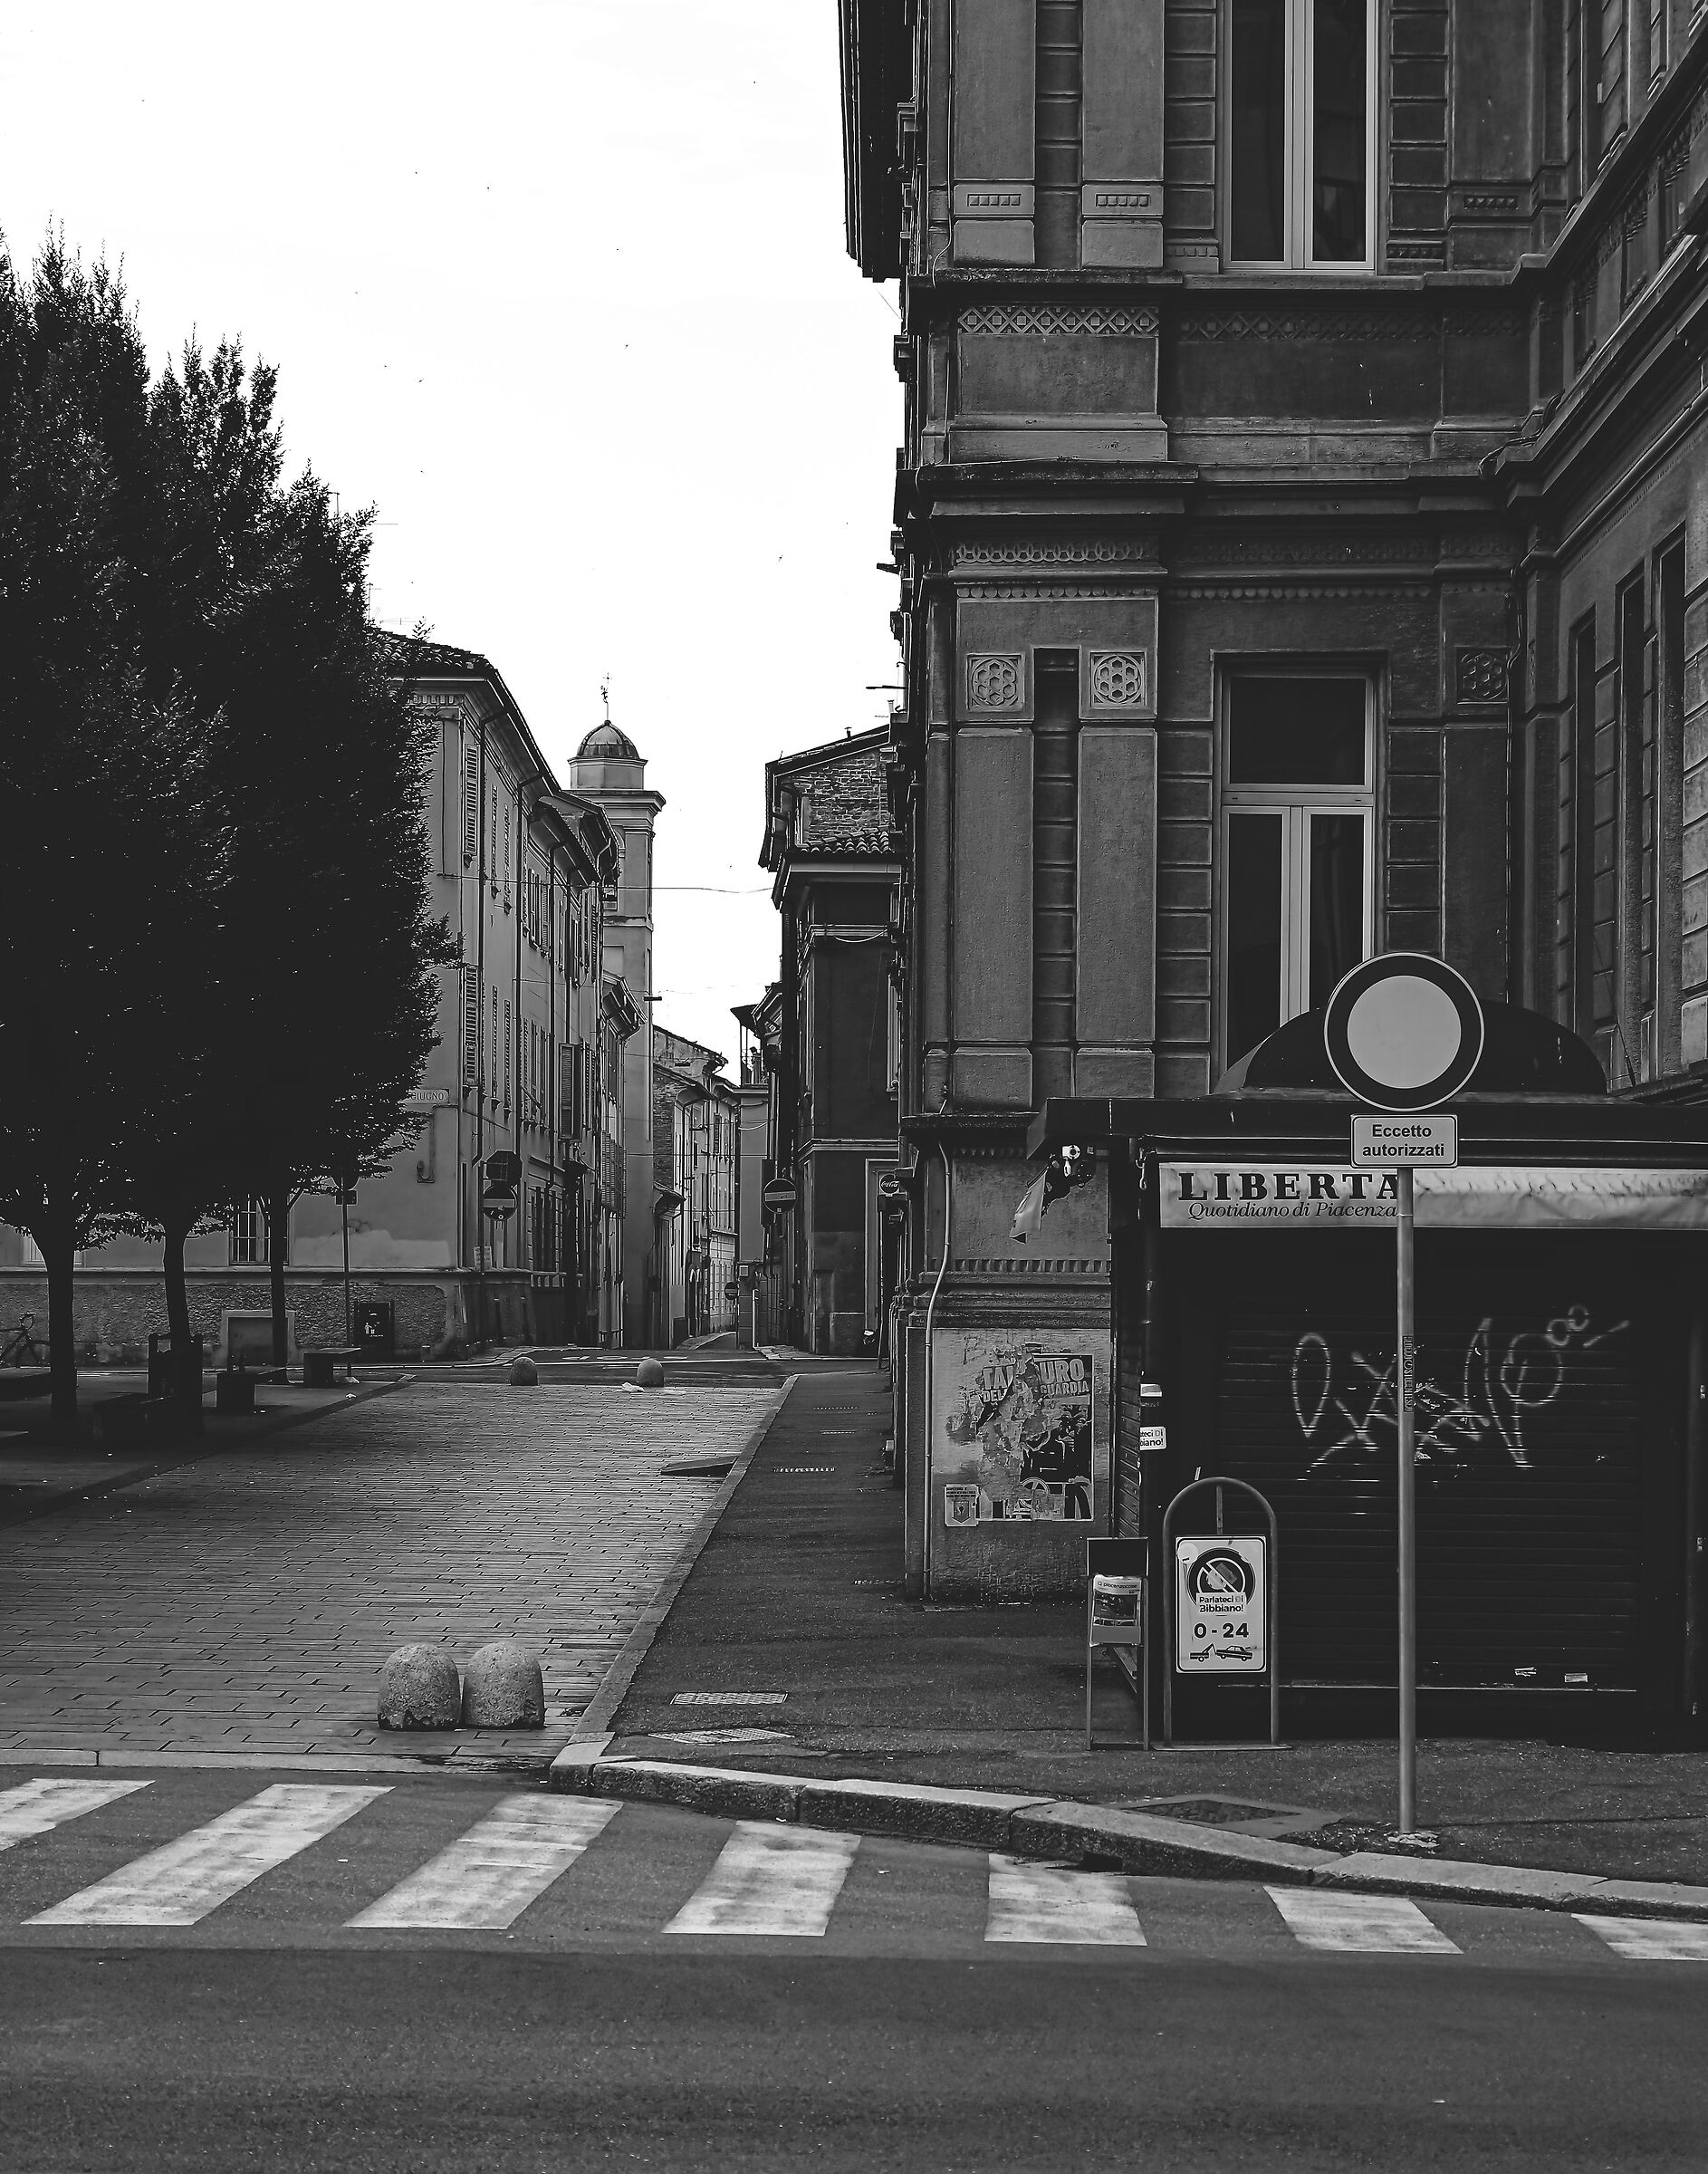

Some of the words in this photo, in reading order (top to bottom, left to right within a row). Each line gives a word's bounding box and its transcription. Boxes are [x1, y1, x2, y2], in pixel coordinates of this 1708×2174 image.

[1372, 1124, 1432, 1138] Eccetto
[1362, 1143, 1444, 1157] autorizzati
[1188, 1202, 1290, 1220] Quotidiano
[1292, 1202, 1310, 1217] di
[1315, 1203, 1397, 1217] Piacenza
[1199, 1595, 1234, 1603] Parlateci
[1199, 1603, 1244, 1612] Bibbiano!
[1223, 1622, 1250, 1639] 24
